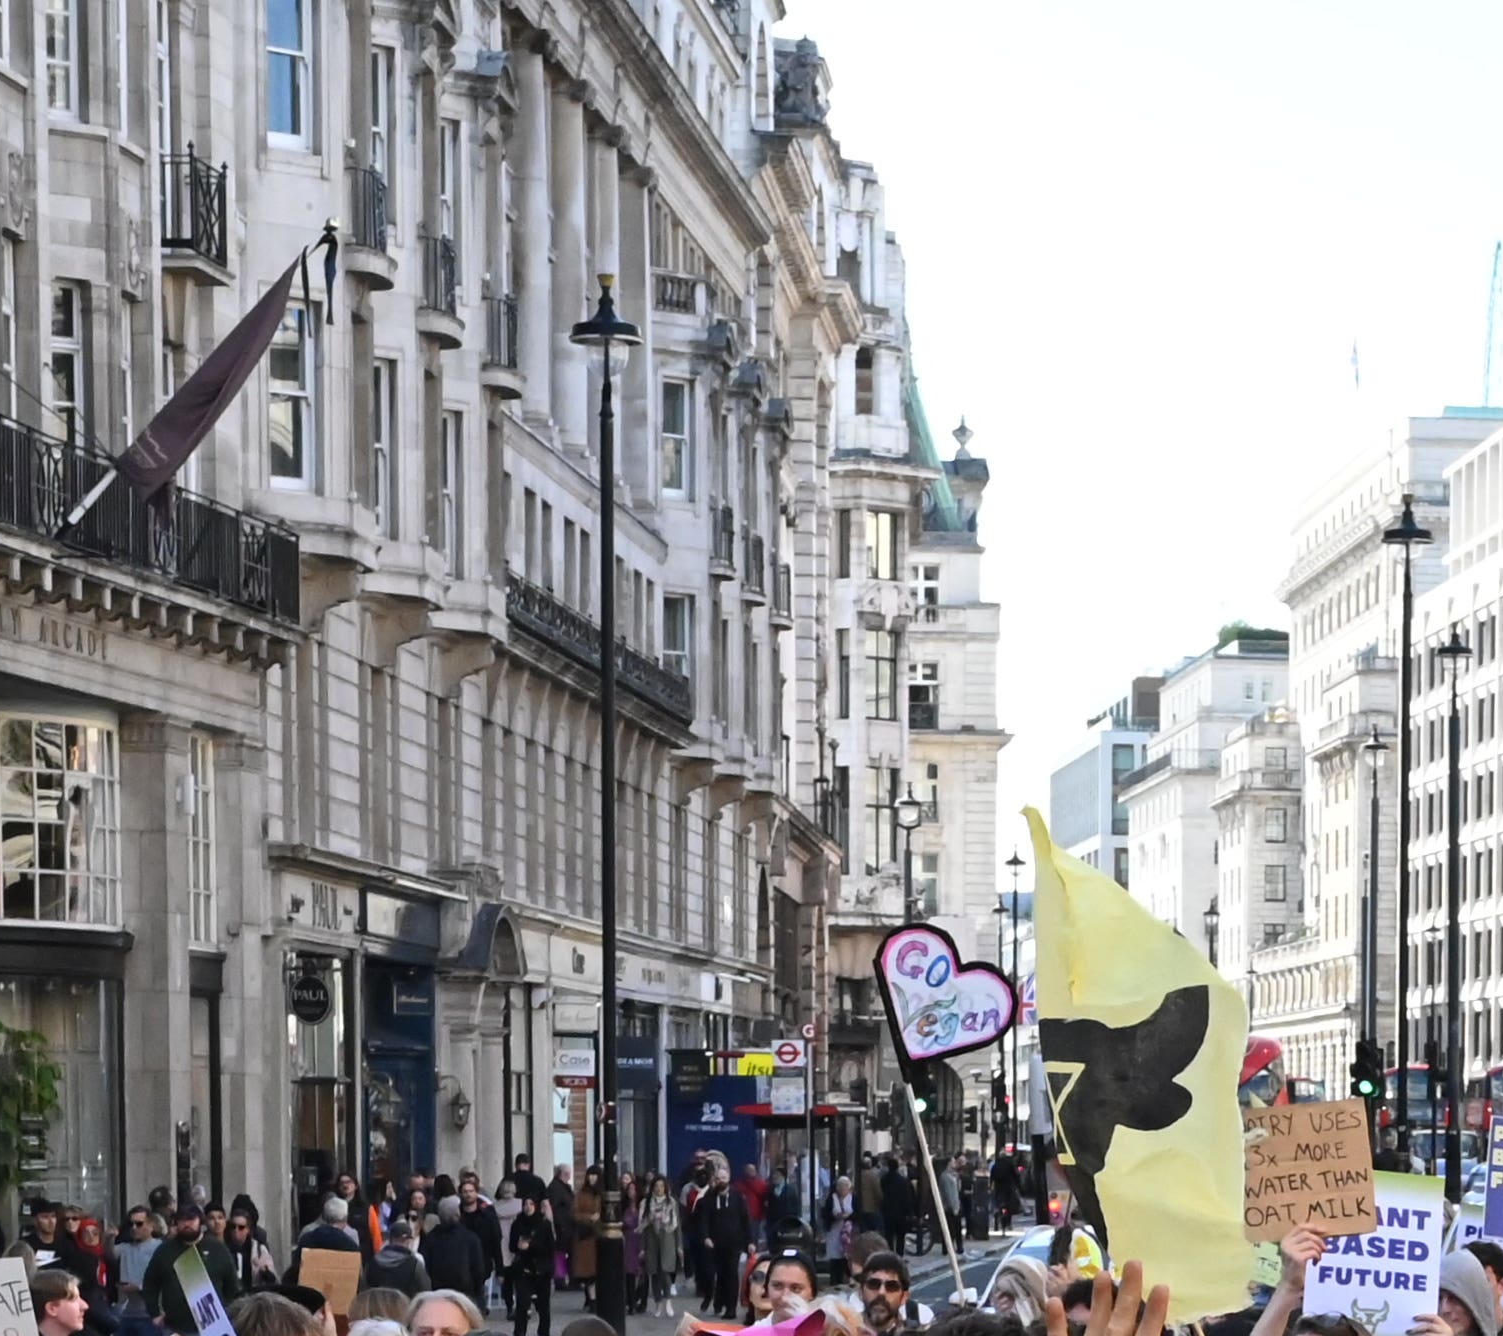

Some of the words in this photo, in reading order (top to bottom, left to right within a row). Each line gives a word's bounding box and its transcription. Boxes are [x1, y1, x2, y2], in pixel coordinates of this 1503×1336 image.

[39, 617, 109, 661] ARCADE
[311, 881, 343, 931] PAUL
[292, 989, 327, 1001] PAUL
[891, 981, 1000, 1047] Vegan
[802, 1024, 815, 1038] G
[558, 1052, 591, 1066] Case
[1310, 1110, 1362, 1134] USES
[1295, 1141, 1347, 1163] MORE
[1245, 1175, 1308, 1199] WATER
[1321, 1168, 1369, 1189] THAN
[1245, 1203, 1294, 1228] OAT
[1306, 1196, 1371, 1222] MILK
[1374, 1209, 1432, 1232] ANT
[1318, 1265, 1428, 1292] FUTURE
